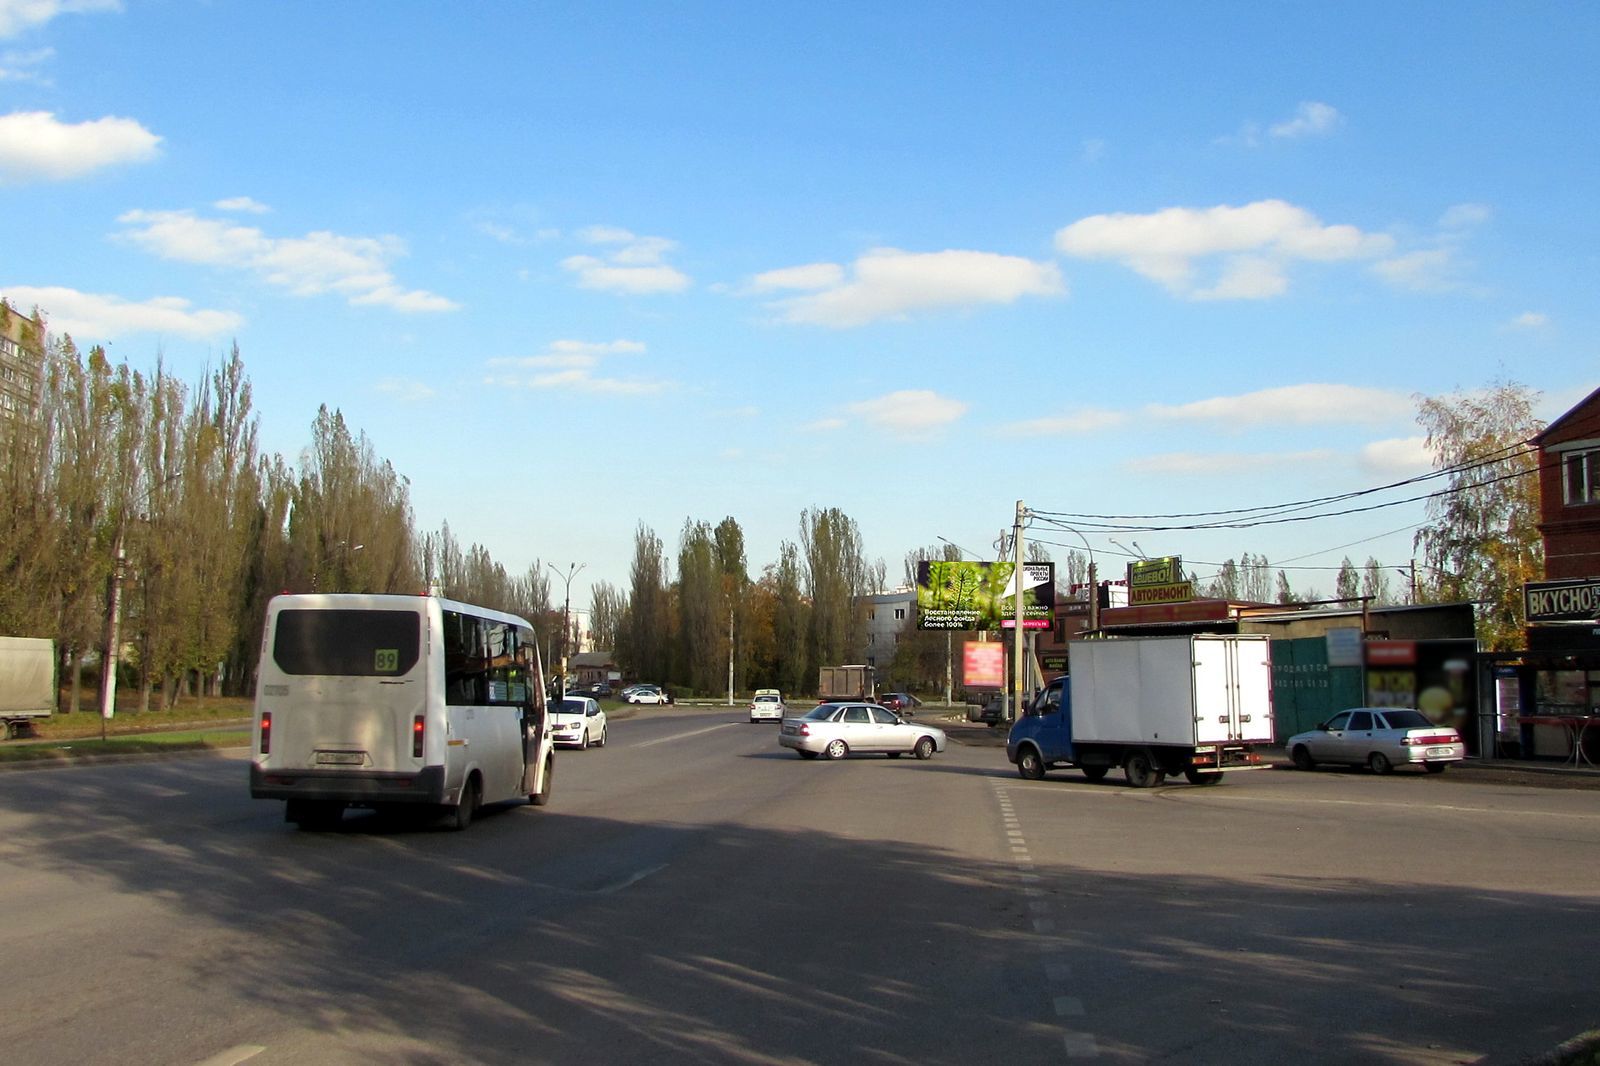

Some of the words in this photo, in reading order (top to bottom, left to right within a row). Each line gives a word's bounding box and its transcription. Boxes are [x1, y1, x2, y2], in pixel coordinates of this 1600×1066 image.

[1131, 586, 1188, 602] АВТОРЕМОНТ
[1529, 587, 1591, 615] ВКУСНО
[376, 653, 395, 669] 89
